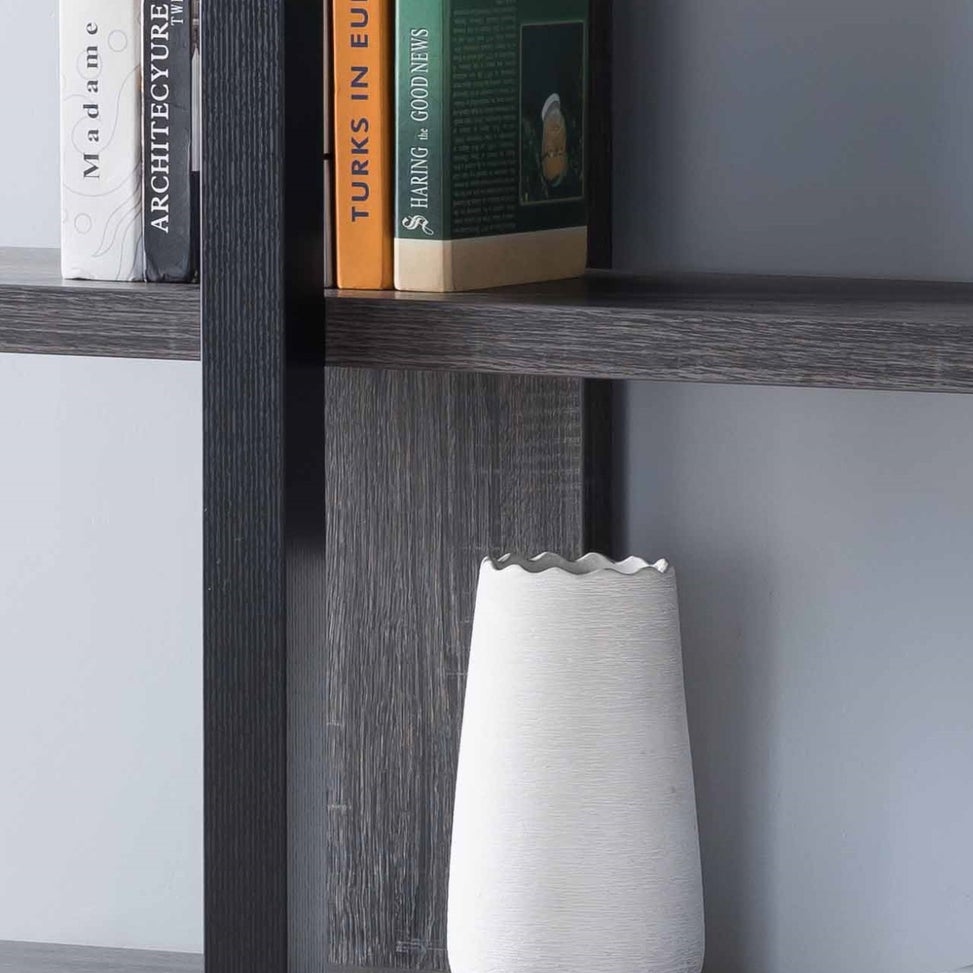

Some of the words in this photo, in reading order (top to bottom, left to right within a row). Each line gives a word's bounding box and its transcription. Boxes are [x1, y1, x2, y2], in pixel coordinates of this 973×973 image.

[351, 0, 368, 48] EU
[83, 22, 99, 178] Madame
[150, 4, 170, 233] ARCHITECYURE
[351, 66, 368, 100] IN
[351, 117, 369, 222] TURKS
[417, 128, 429, 140] the
